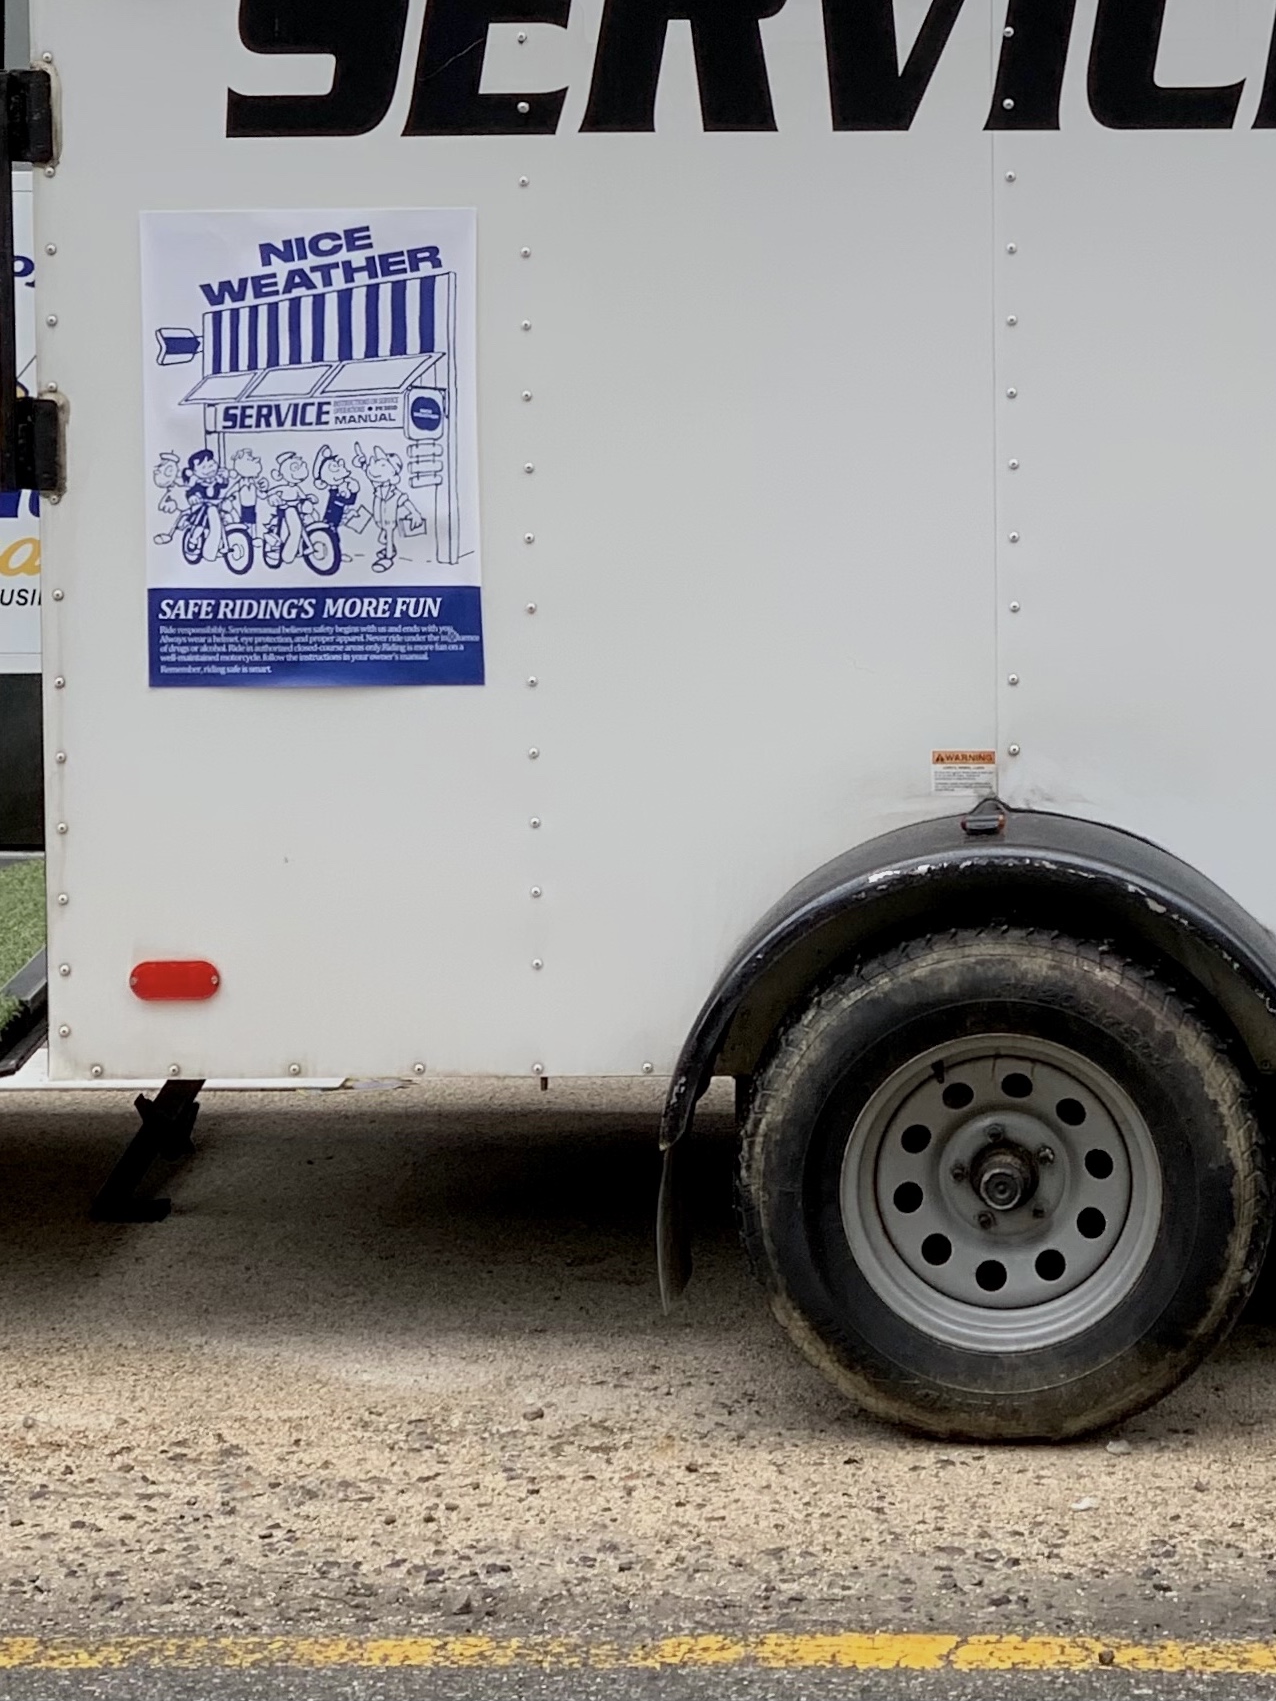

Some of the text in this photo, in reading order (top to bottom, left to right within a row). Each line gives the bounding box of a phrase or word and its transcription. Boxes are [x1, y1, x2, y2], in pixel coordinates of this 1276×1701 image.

[258, 225, 374, 267] NICE
[198, 245, 443, 307] WEATHER
[221, 401, 333, 430] SERVICE
[334, 413, 397, 425] MANUAL
[0, 588, 42, 606] USI
[157, 596, 443, 620] SAFE RIDING'S MORE FUN
[945, 753, 993, 763] WARNING
